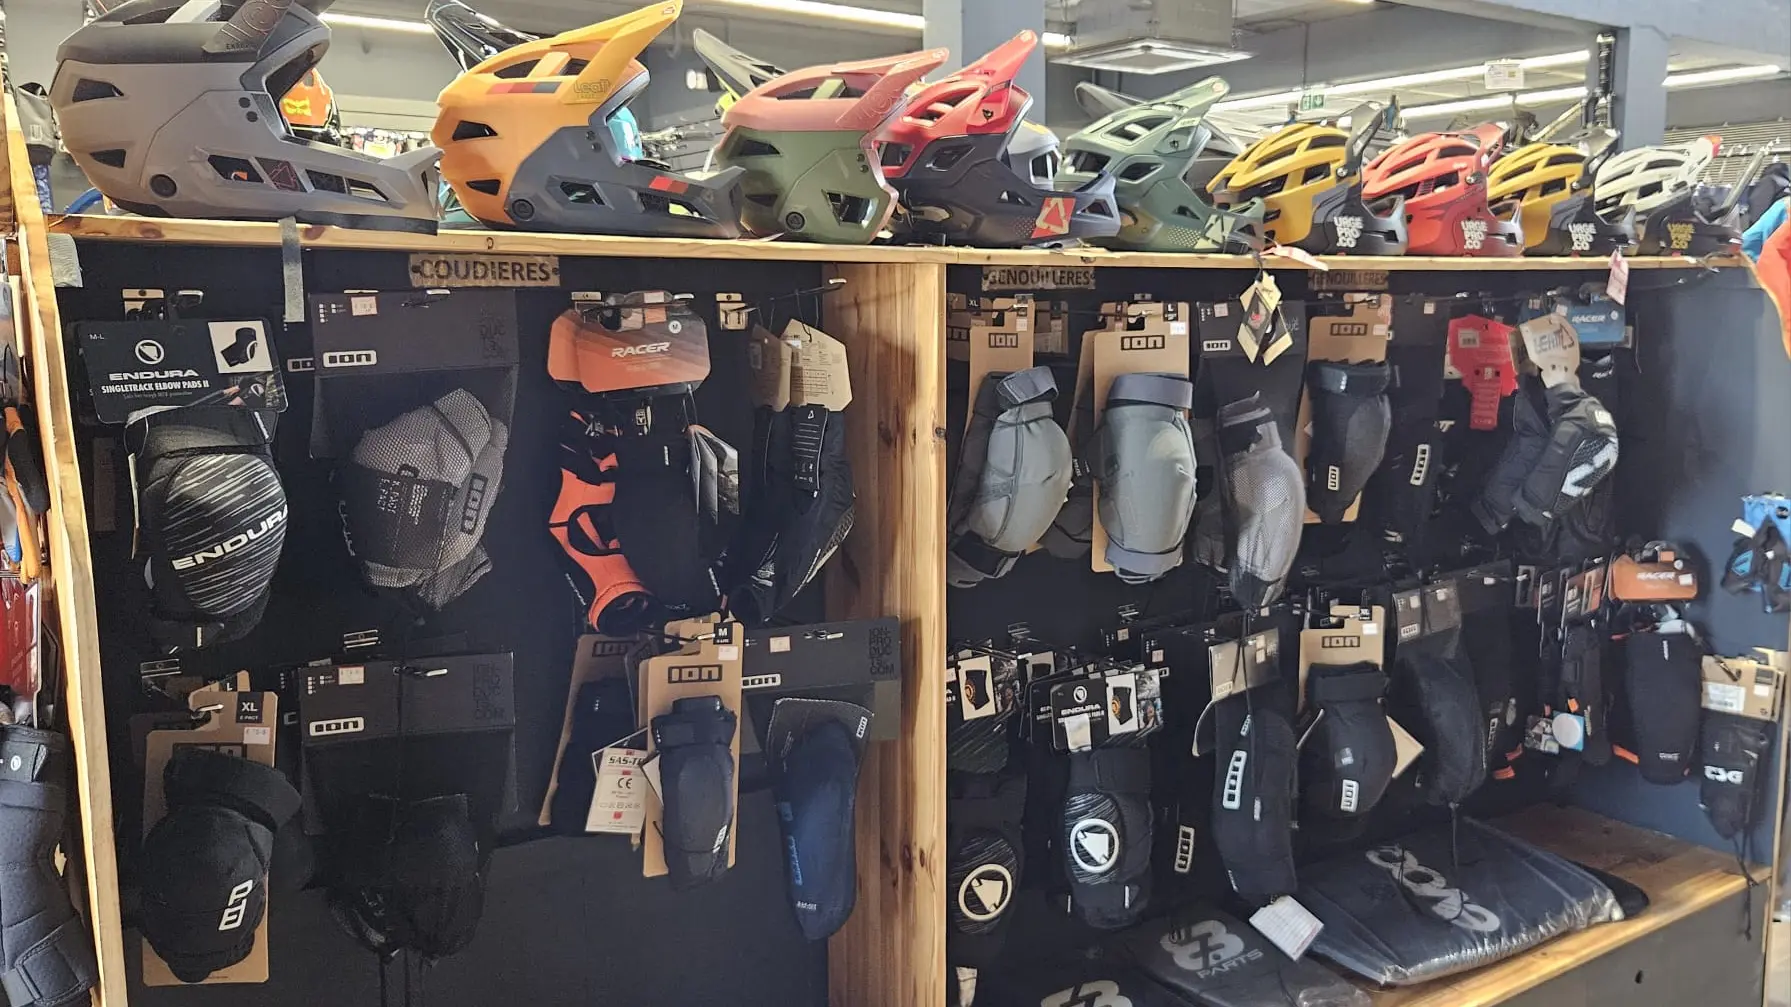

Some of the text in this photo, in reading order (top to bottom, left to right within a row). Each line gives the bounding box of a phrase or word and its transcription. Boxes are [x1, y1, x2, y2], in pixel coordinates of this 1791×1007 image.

[1334, 216, 1363, 229] URGE
[1461, 219, 1488, 232] URGE
[1568, 222, 1596, 234] URGE
[1337, 227, 1361, 238] PRO
[1464, 230, 1485, 241] PRO
[1571, 232, 1594, 243] PRO
[420, 259, 551, 281] COUDIERES
[1571, 314, 1606, 323] RACER
[612, 342, 671, 357] RACER
[108, 369, 200, 381] ENDURA
[101, 382, 154, 394] SINGLETRACK
[155, 380, 181, 391] ELBOW
[182, 380, 202, 389] PADS
[718, 628, 728, 637] M
[241, 701, 259, 712] XL
[1060, 704, 1101, 716] ENDURA
[1196, 948, 1264, 979] PARTS
